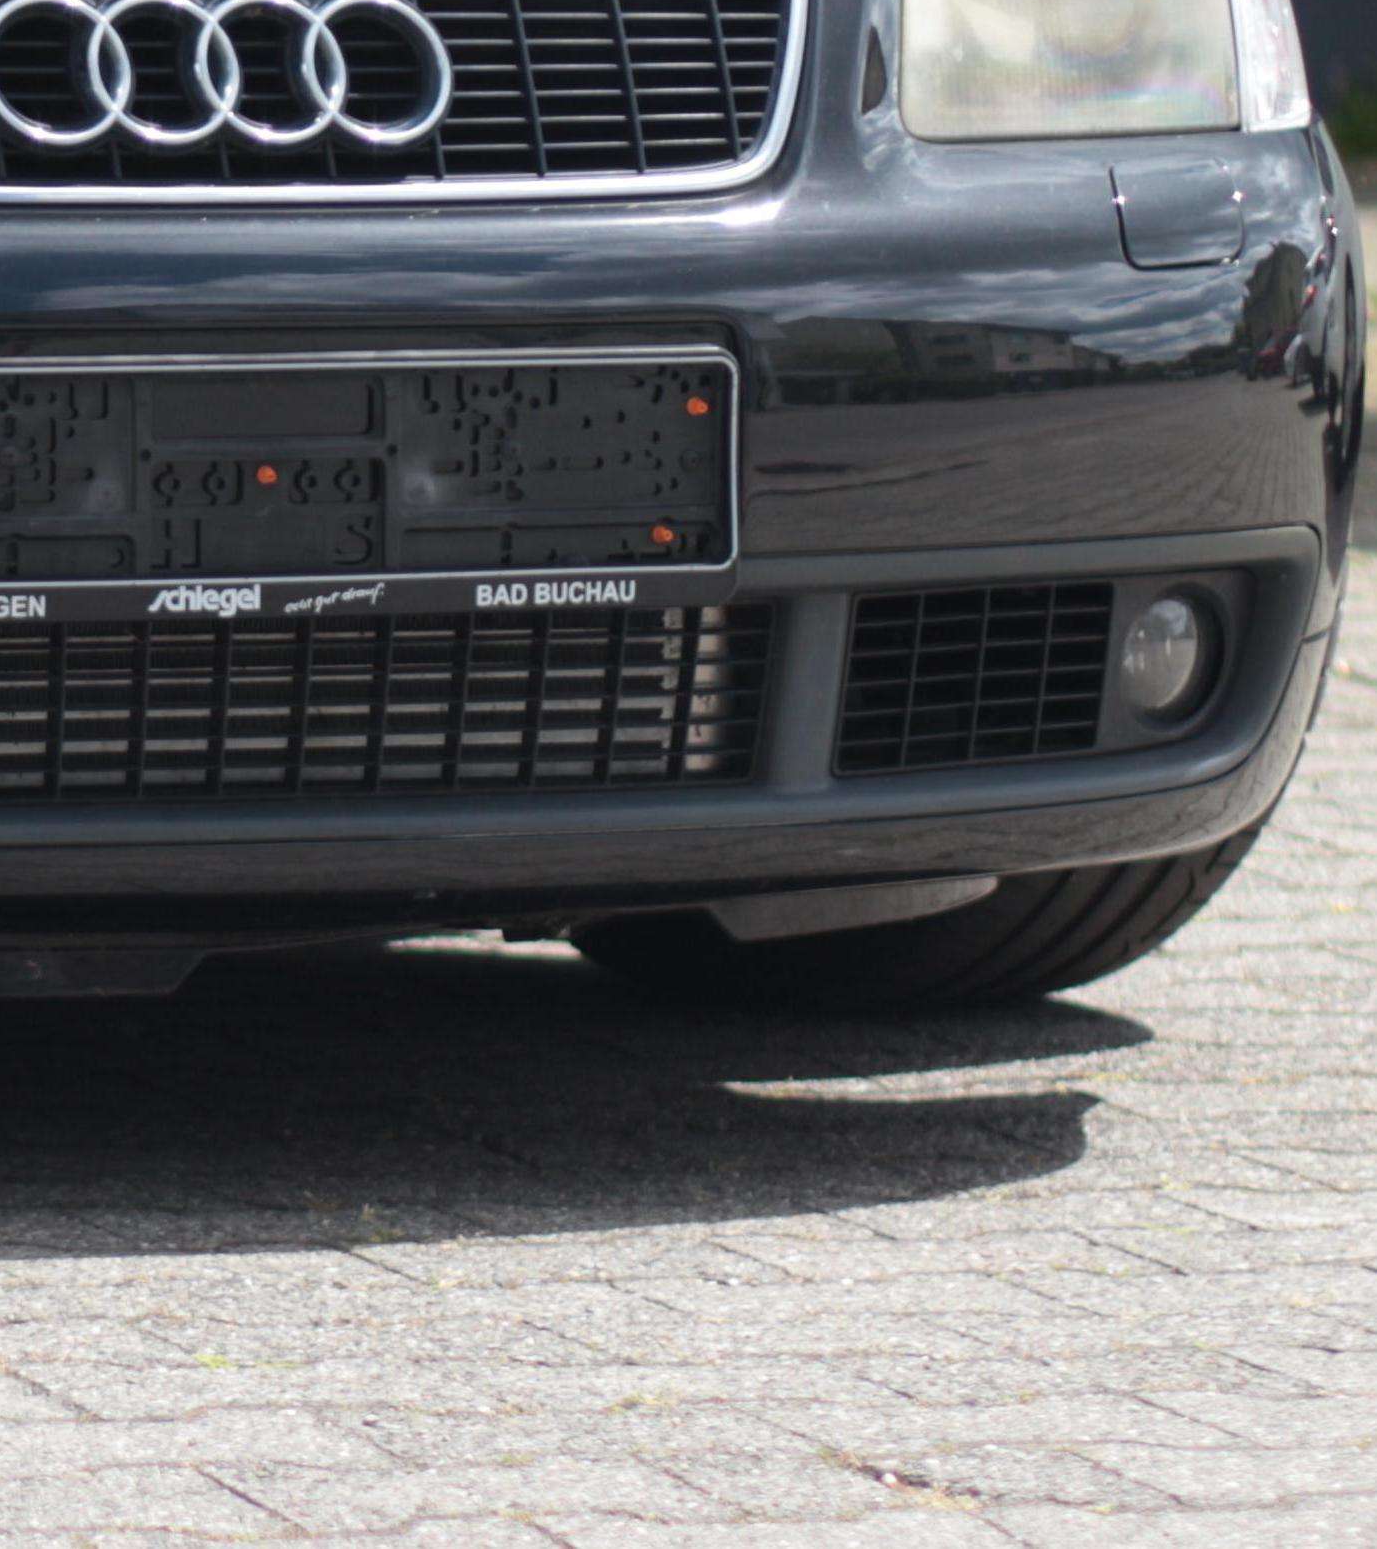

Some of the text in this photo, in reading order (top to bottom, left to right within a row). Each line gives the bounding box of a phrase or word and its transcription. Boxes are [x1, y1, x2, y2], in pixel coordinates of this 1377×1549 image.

[147, 583, 262, 619] schlegel
[475, 579, 637, 607] BAD BUCHAU
